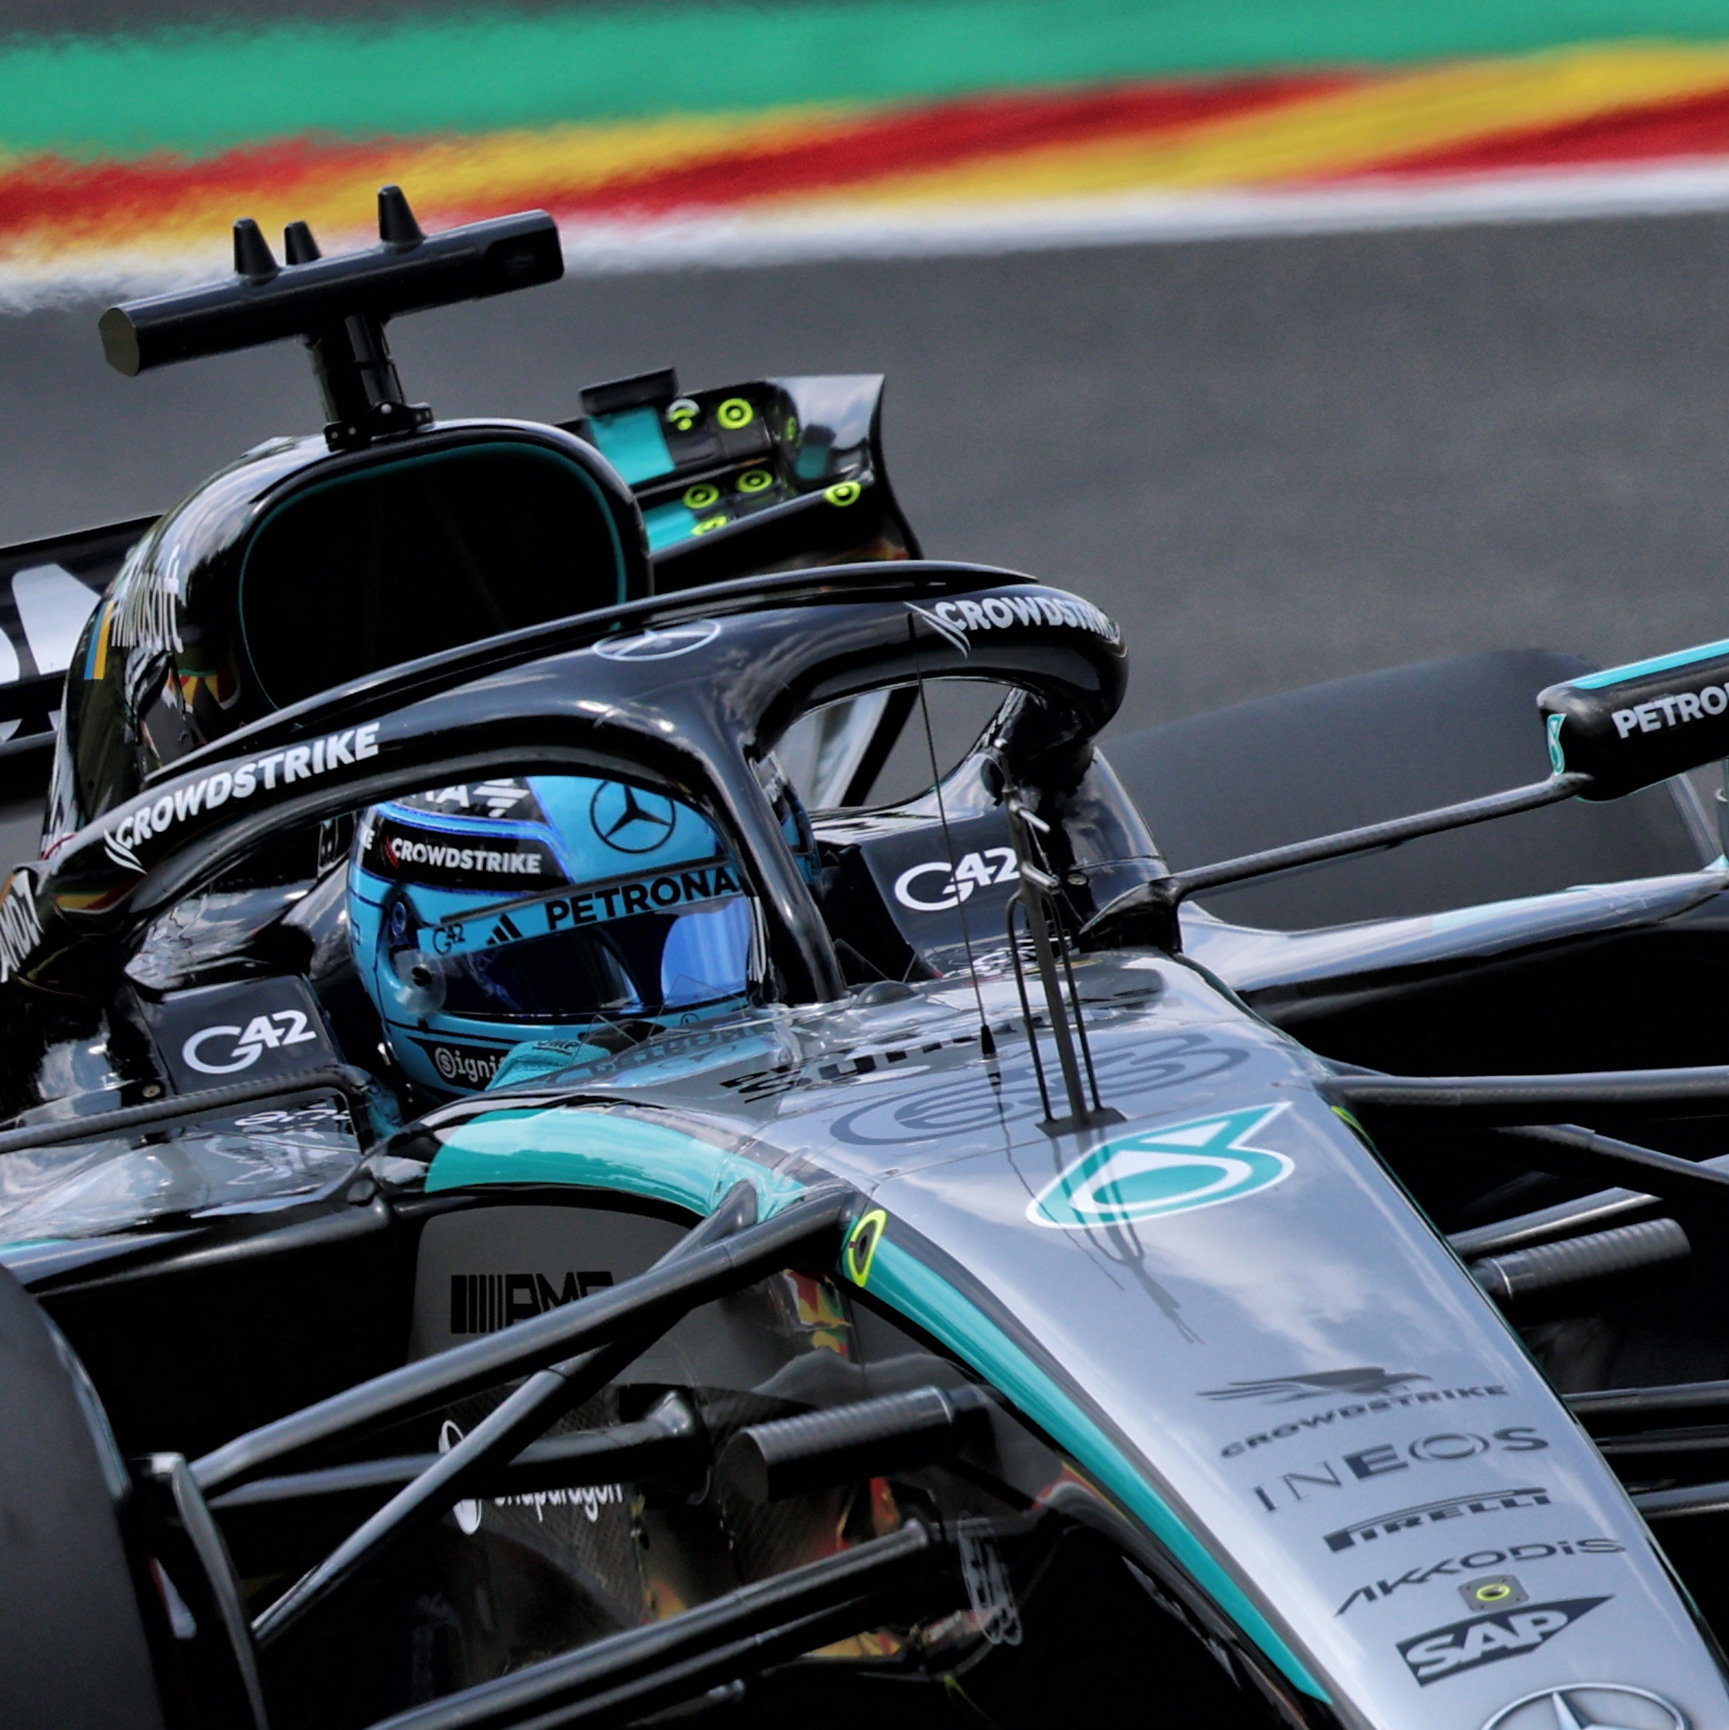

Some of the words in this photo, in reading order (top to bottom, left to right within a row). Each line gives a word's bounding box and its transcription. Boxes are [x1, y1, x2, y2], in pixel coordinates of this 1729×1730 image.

[115, 722, 381, 851] CROWDSTRIKE
[391, 837, 542, 874] CROWDSTRIKE
[894, 846, 1021, 912] G42
[545, 866, 743, 931] PETRONA
[182, 1009, 317, 1075] G42
[1220, 1384, 1509, 1459] CROWDSTRIKE
[1253, 1426, 1550, 1513] INEOS
[1323, 1486, 1553, 1554] PIRELLI
[1405, 1608, 1570, 1677] SAP
